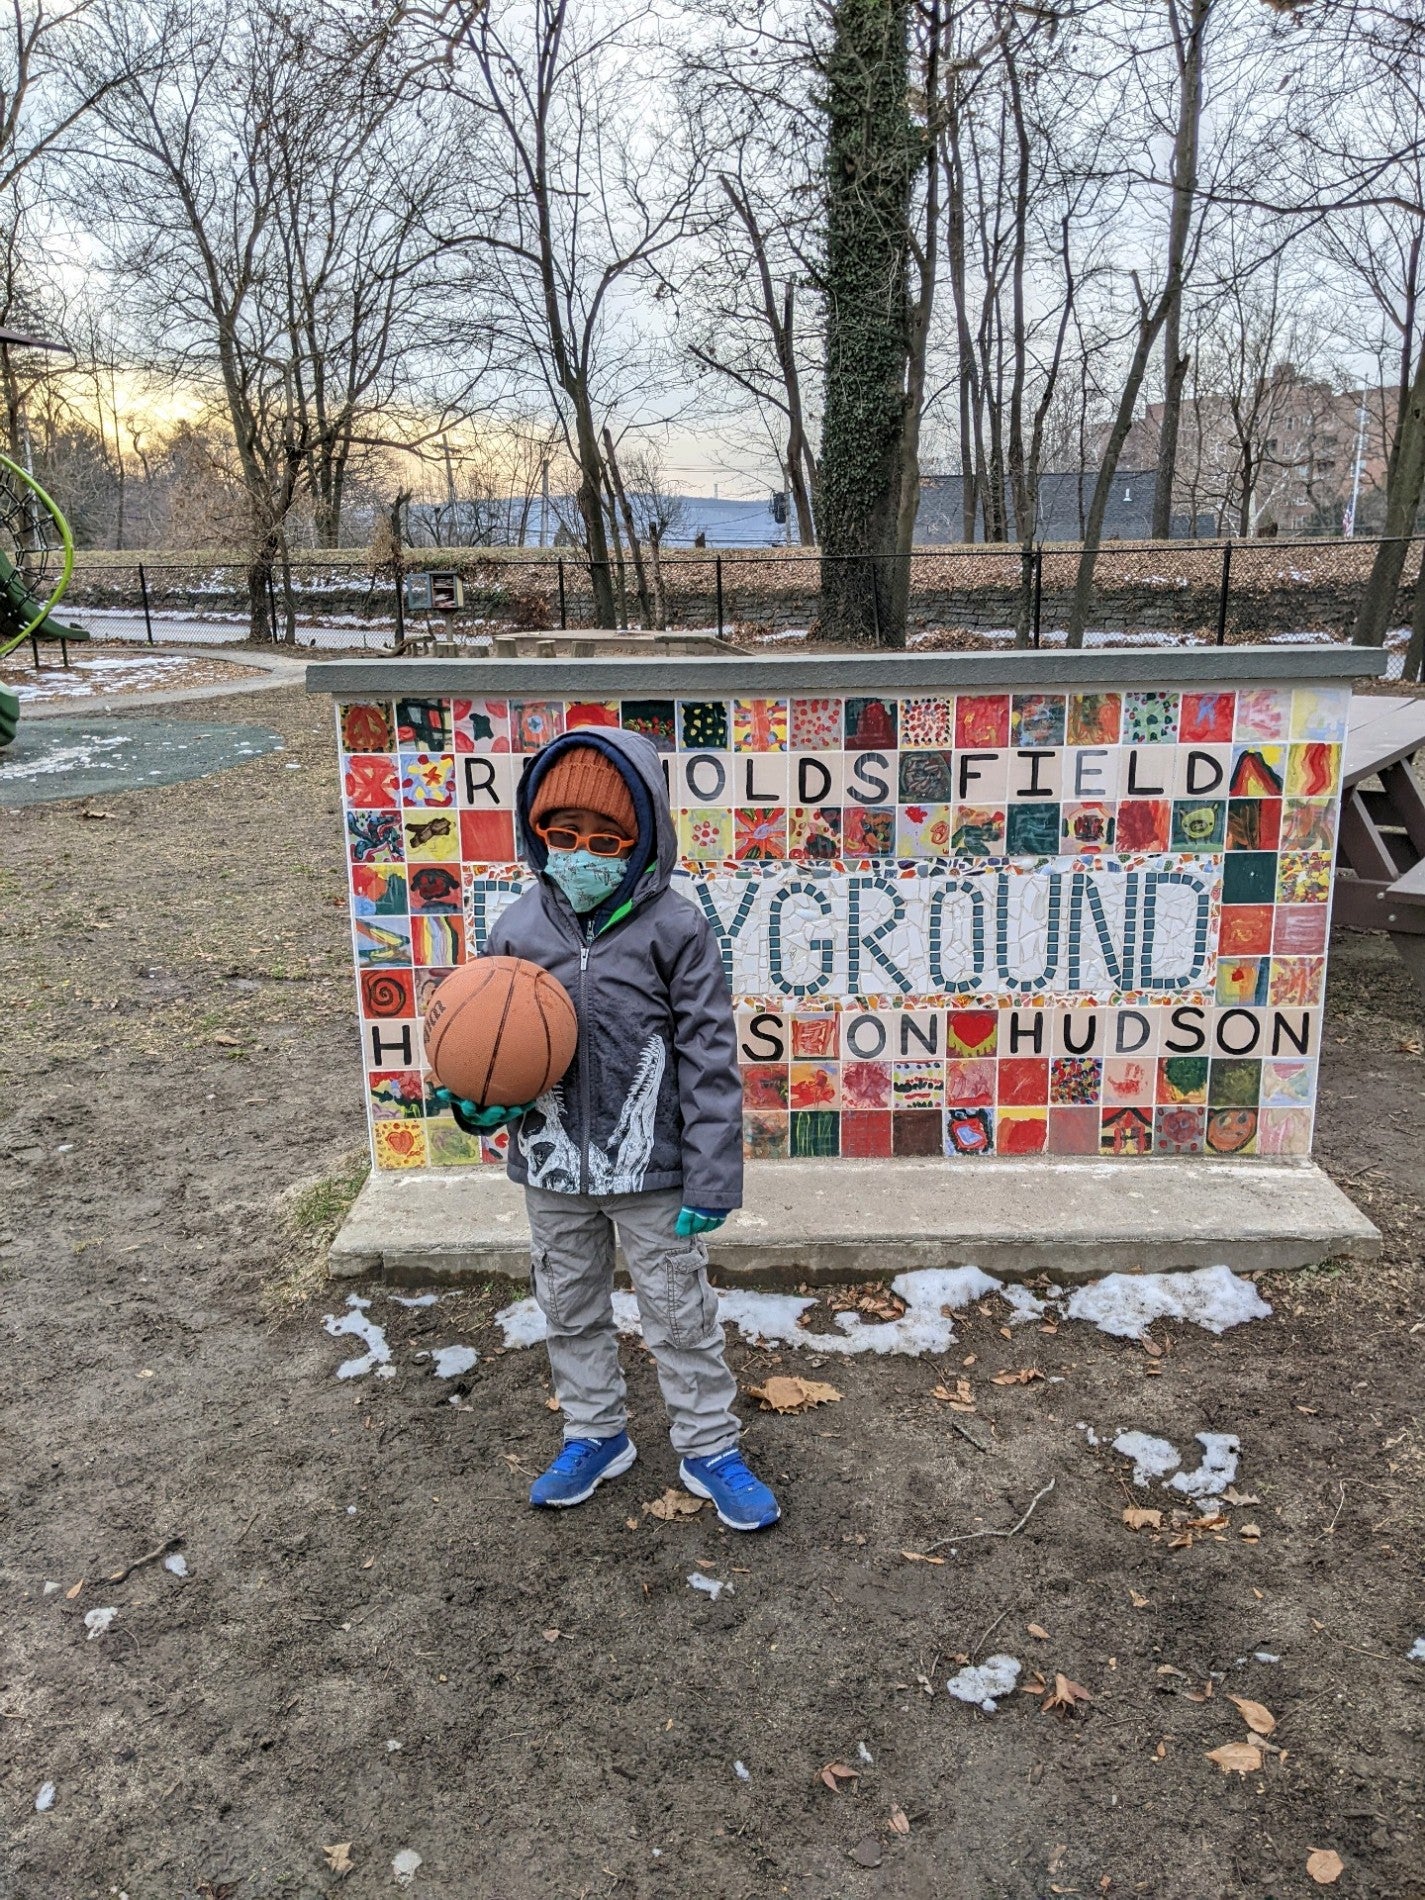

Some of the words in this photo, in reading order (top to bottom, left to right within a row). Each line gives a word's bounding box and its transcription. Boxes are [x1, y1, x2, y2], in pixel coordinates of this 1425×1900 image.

[464, 751, 889, 805] ROLDS
[959, 750, 1223, 799] FIELD
[474, 872, 1210, 995] YGROUND
[846, 1012, 938, 1059] ON
[1010, 1007, 1309, 1057] HUDSON
